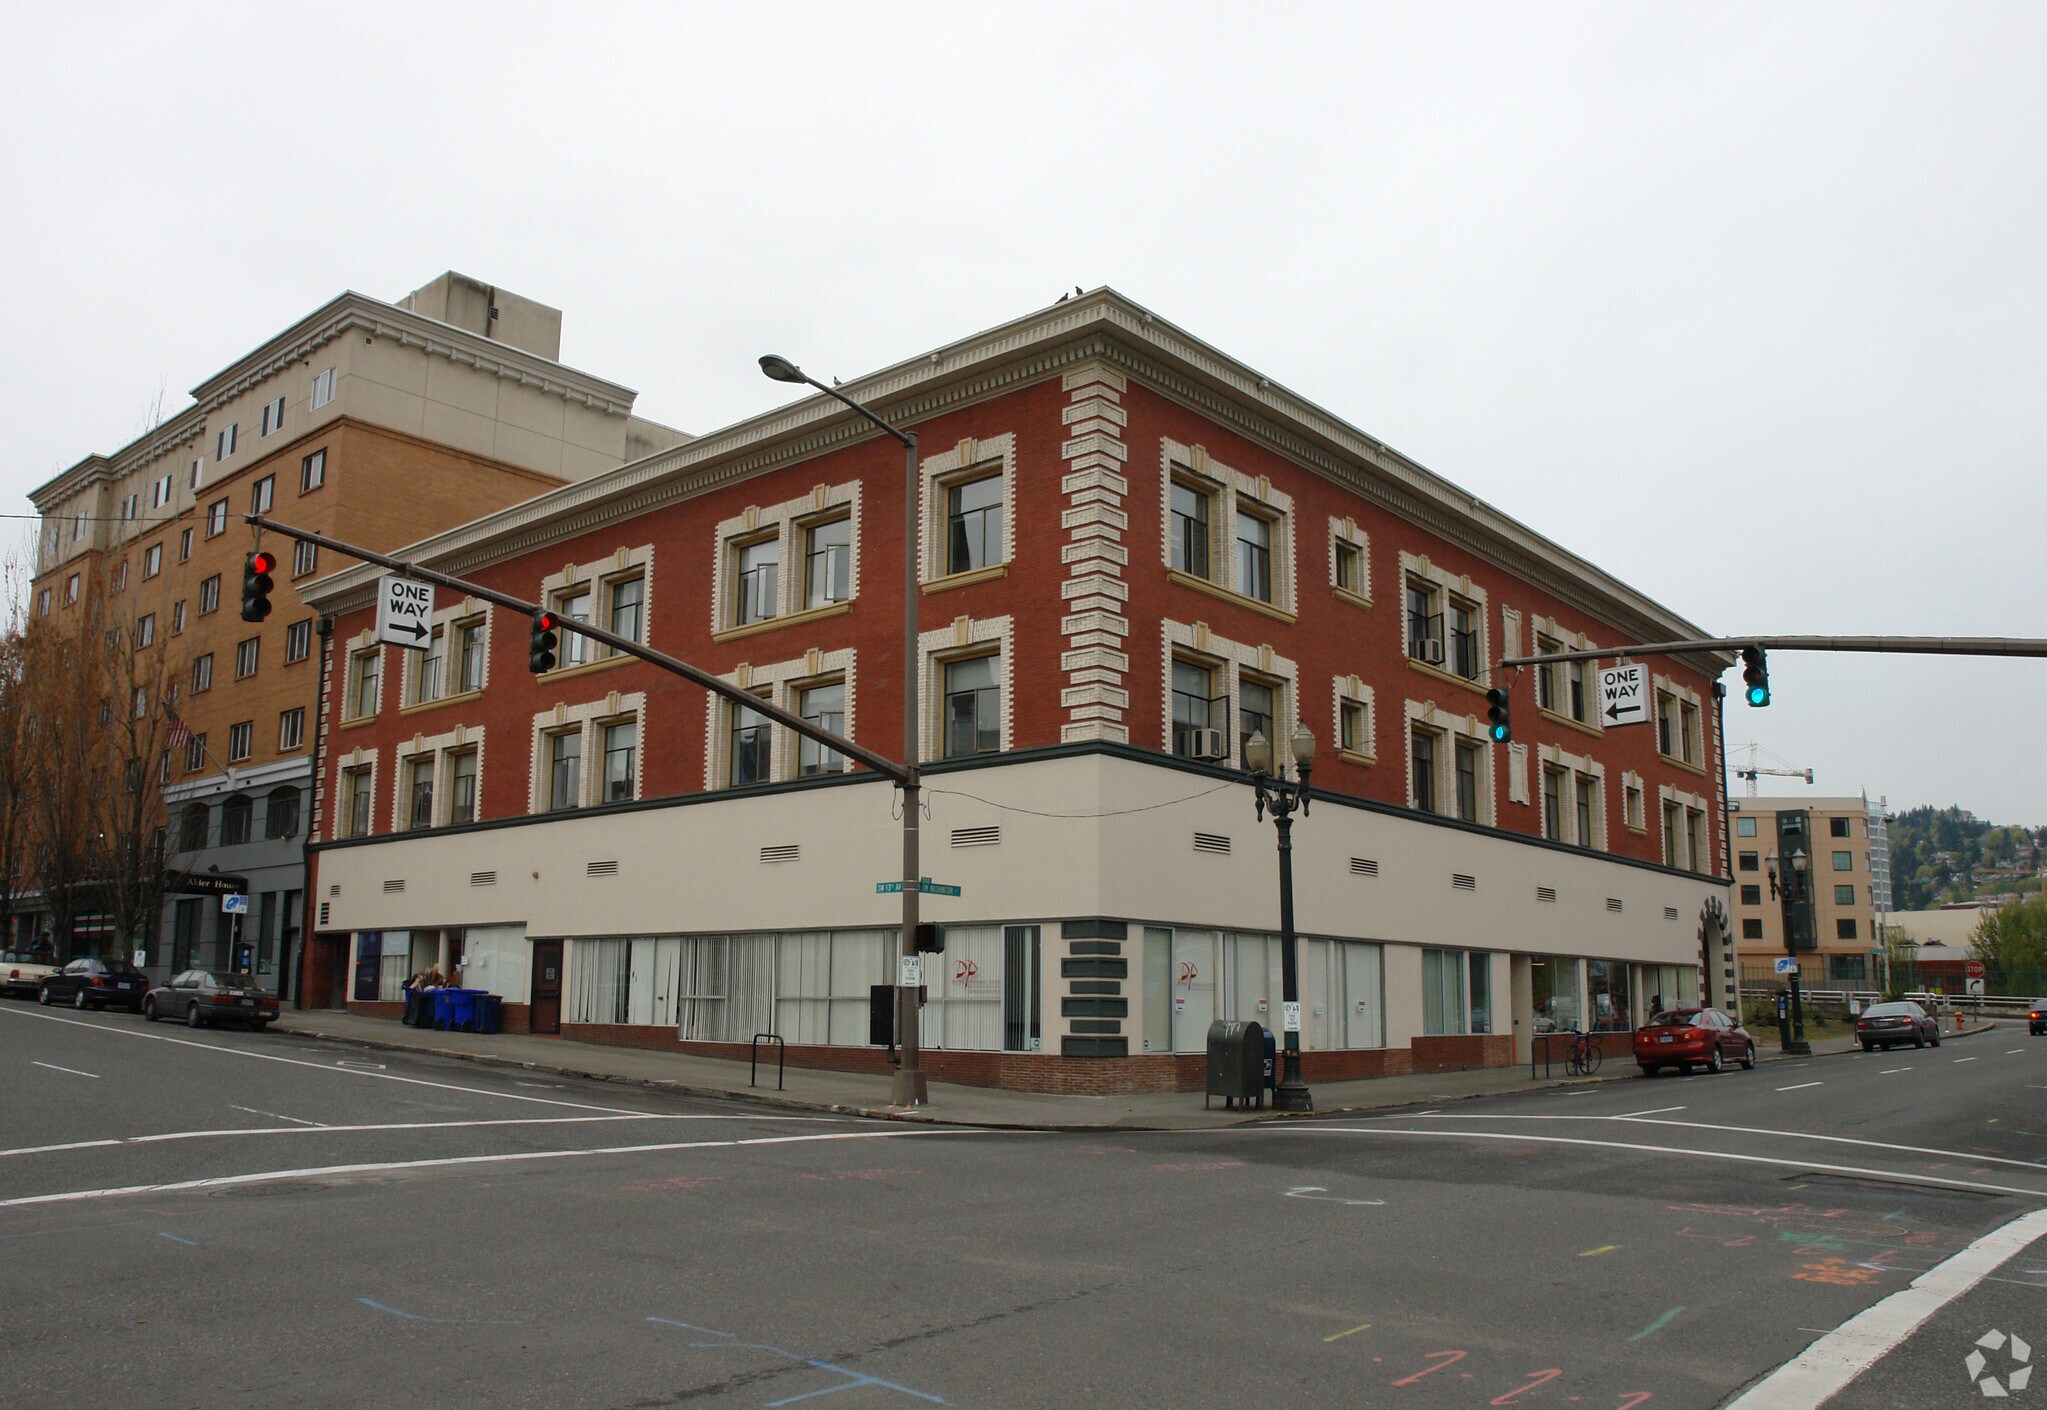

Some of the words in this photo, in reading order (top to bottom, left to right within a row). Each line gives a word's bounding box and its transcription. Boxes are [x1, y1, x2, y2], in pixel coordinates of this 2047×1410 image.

[391, 582, 429, 602] ONE
[390, 599, 429, 618] WAY
[1604, 669, 1639, 685] ONE
[1604, 683, 1640, 701] WAY
[187, 878, 211, 887] Alder
[877, 884, 885, 892] SW
